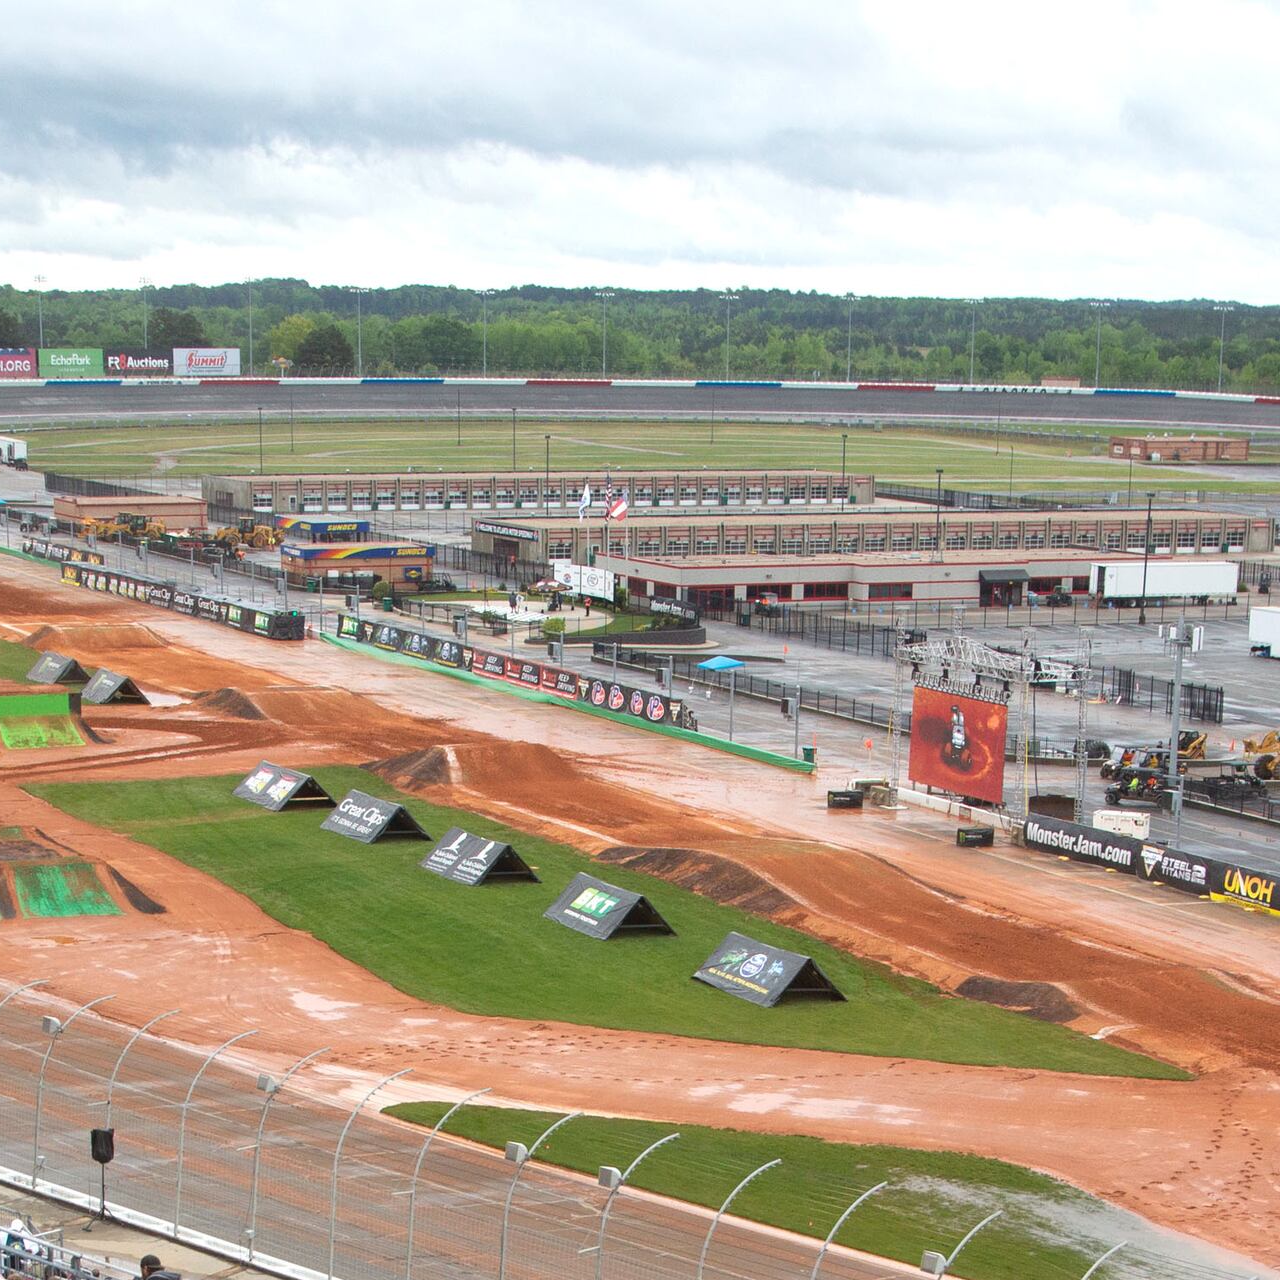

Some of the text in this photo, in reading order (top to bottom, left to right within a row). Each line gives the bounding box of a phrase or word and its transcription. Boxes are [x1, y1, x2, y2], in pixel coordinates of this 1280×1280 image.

[50, 354, 90, 366] EchoPark
[327, 524, 358, 532] SUNOCO
[396, 548, 427, 556] SUNOCO
[340, 798, 386, 826] Great Clips
[1027, 822, 1132, 866] MonsterJam.com
[1162, 856, 1192, 872] STEEL
[1162, 866, 1192, 882] TITANS
[1191, 864, 1206, 881] 2
[1224, 868, 1274, 903] UNOH
[575, 890, 617, 915] BKT
